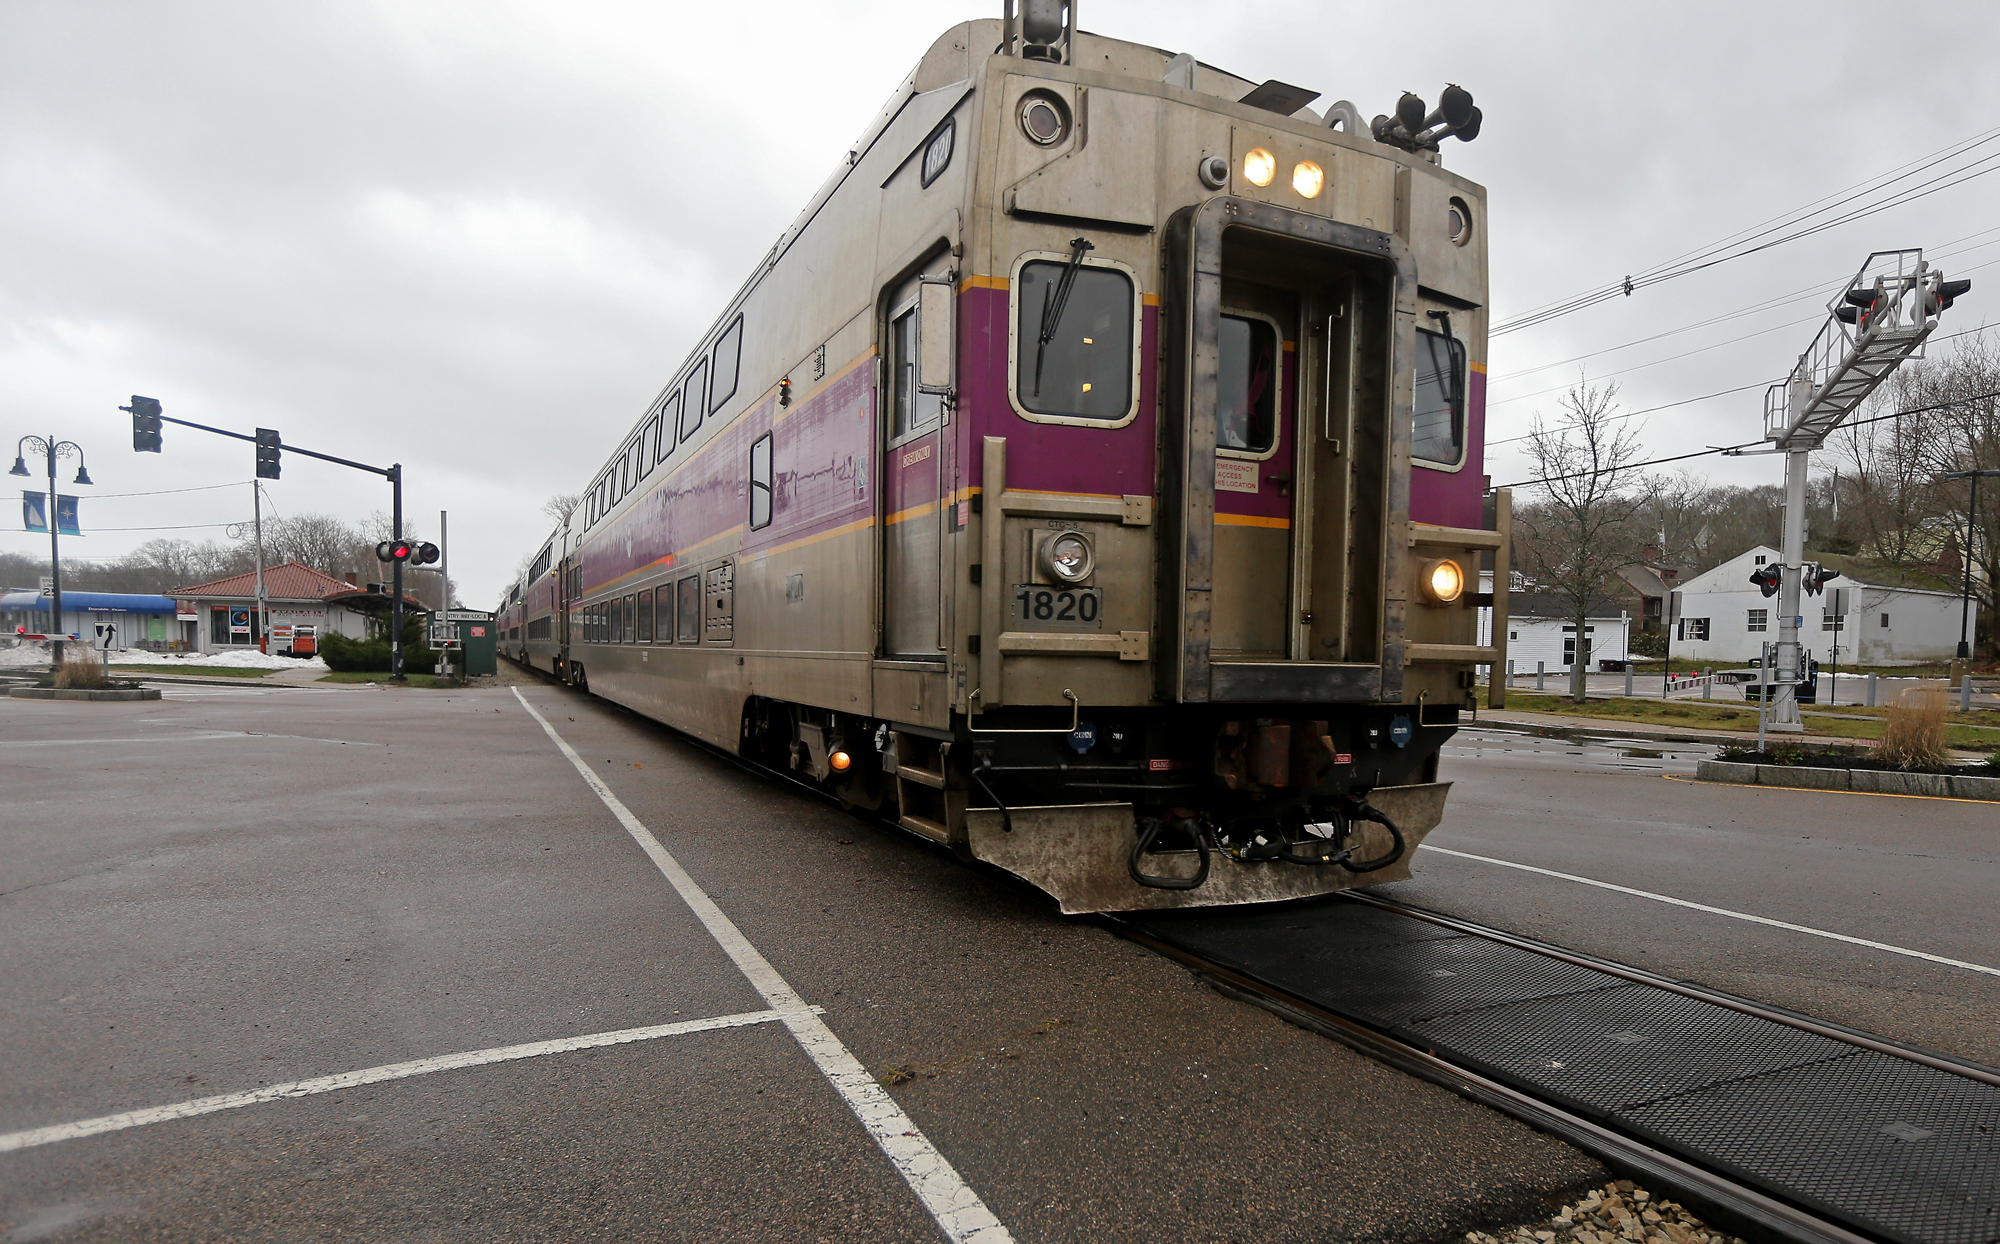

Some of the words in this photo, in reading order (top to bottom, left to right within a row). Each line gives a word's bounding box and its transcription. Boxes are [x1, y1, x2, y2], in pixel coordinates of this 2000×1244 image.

[925, 129, 953, 178] 1820
[917, 446, 931, 461] ONLY
[1216, 463, 1254, 472] EMERGENCY
[1226, 481, 1256, 489] LOCATION
[1017, 590, 1098, 622] 1820
